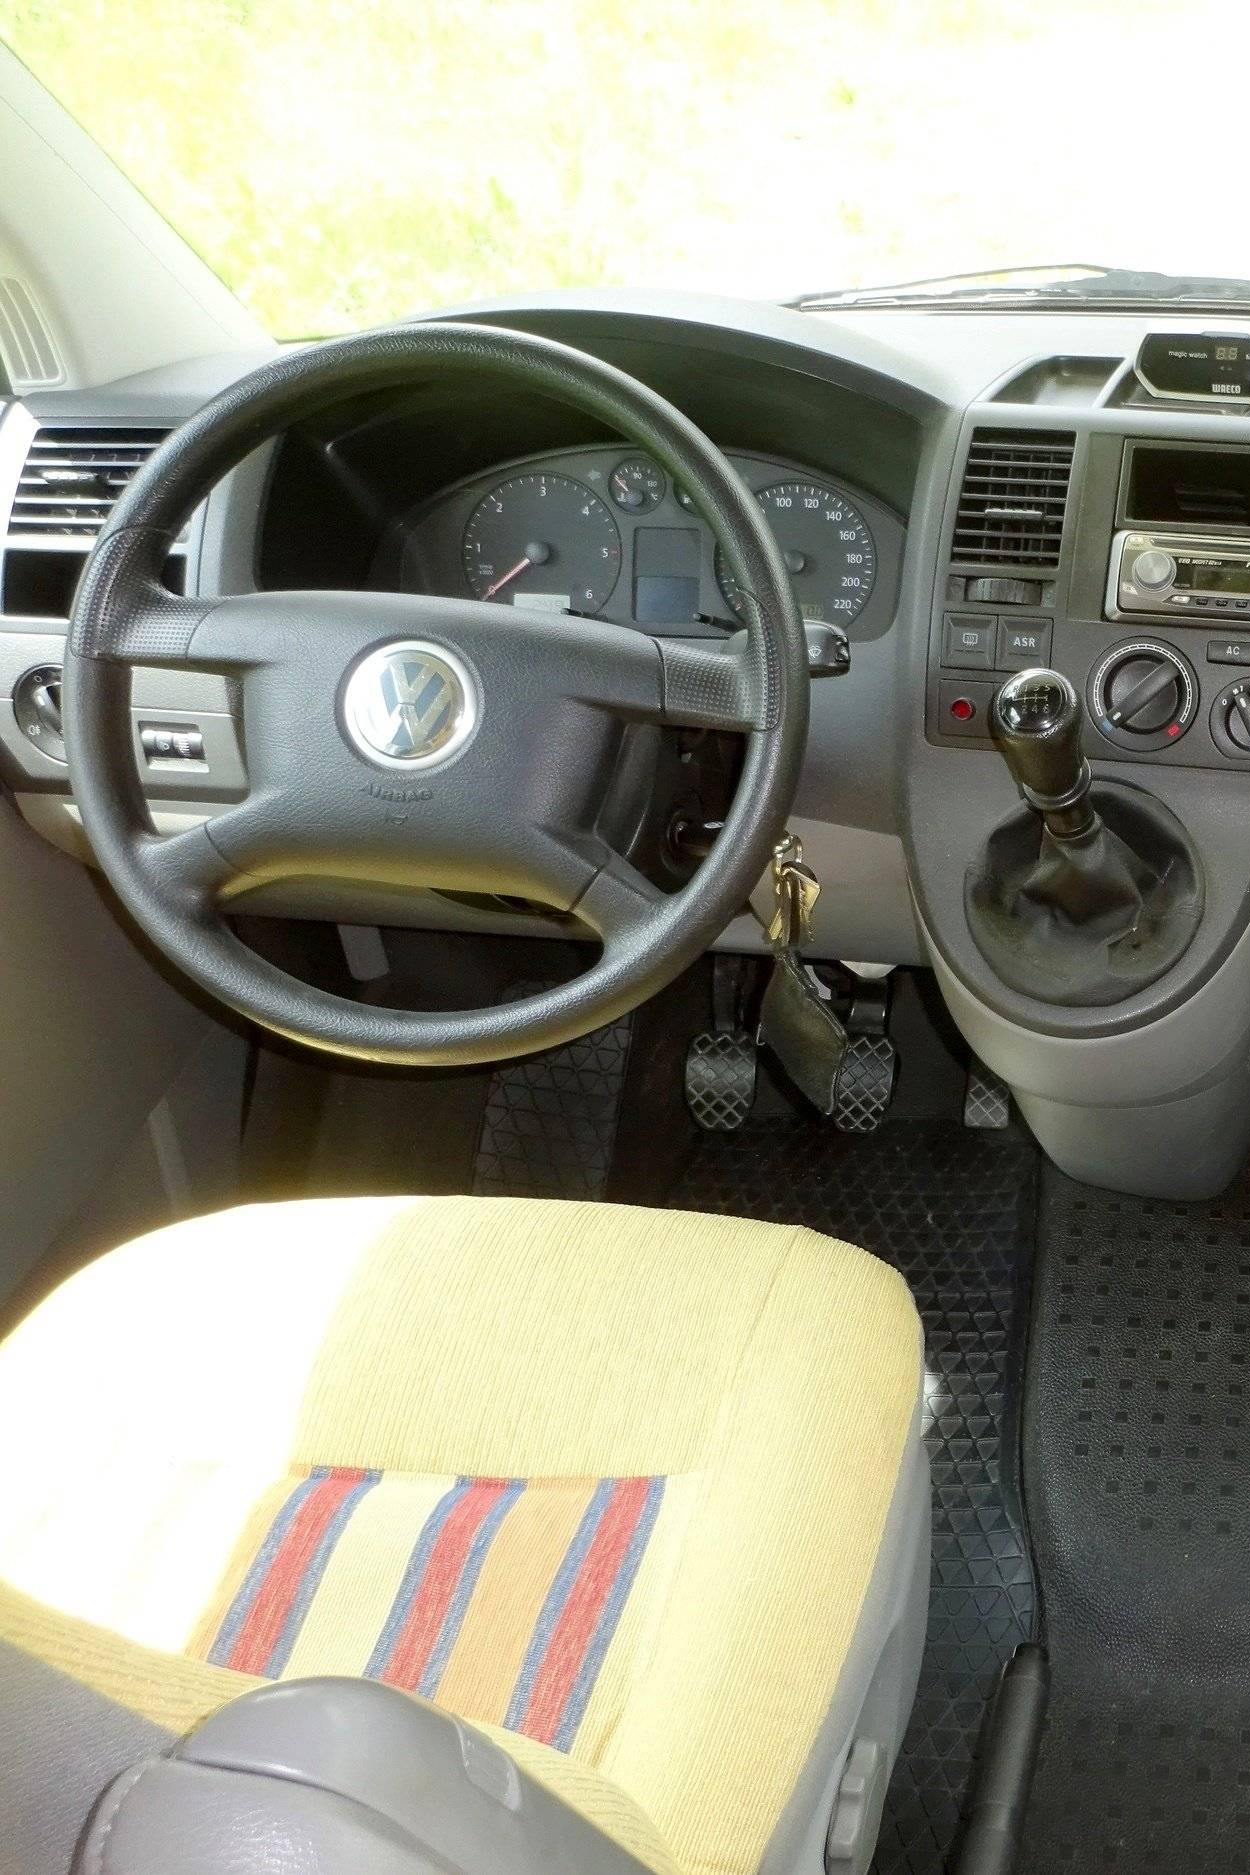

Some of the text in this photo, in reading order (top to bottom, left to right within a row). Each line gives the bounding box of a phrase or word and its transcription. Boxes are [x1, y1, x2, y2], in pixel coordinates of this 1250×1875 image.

[1168, 350, 1208, 359] magic watch
[1211, 383, 1241, 394] WAECO
[540, 486, 547, 497] 3
[496, 502, 503, 513] 2
[776, 497, 792, 508] 100
[804, 499, 819, 509] 120
[581, 505, 590, 516] 4
[826, 511, 842, 521] 140
[839, 531, 856, 541] 160
[476, 543, 481, 552] 1
[602, 548, 609, 558] 5
[846, 554, 863, 564] 180
[842, 577, 860, 587] 200
[585, 589, 593, 599] 6
[833, 600, 851, 609] 220
[1013, 636, 1036, 648] ASR
[1226, 646, 1240, 656] AC
